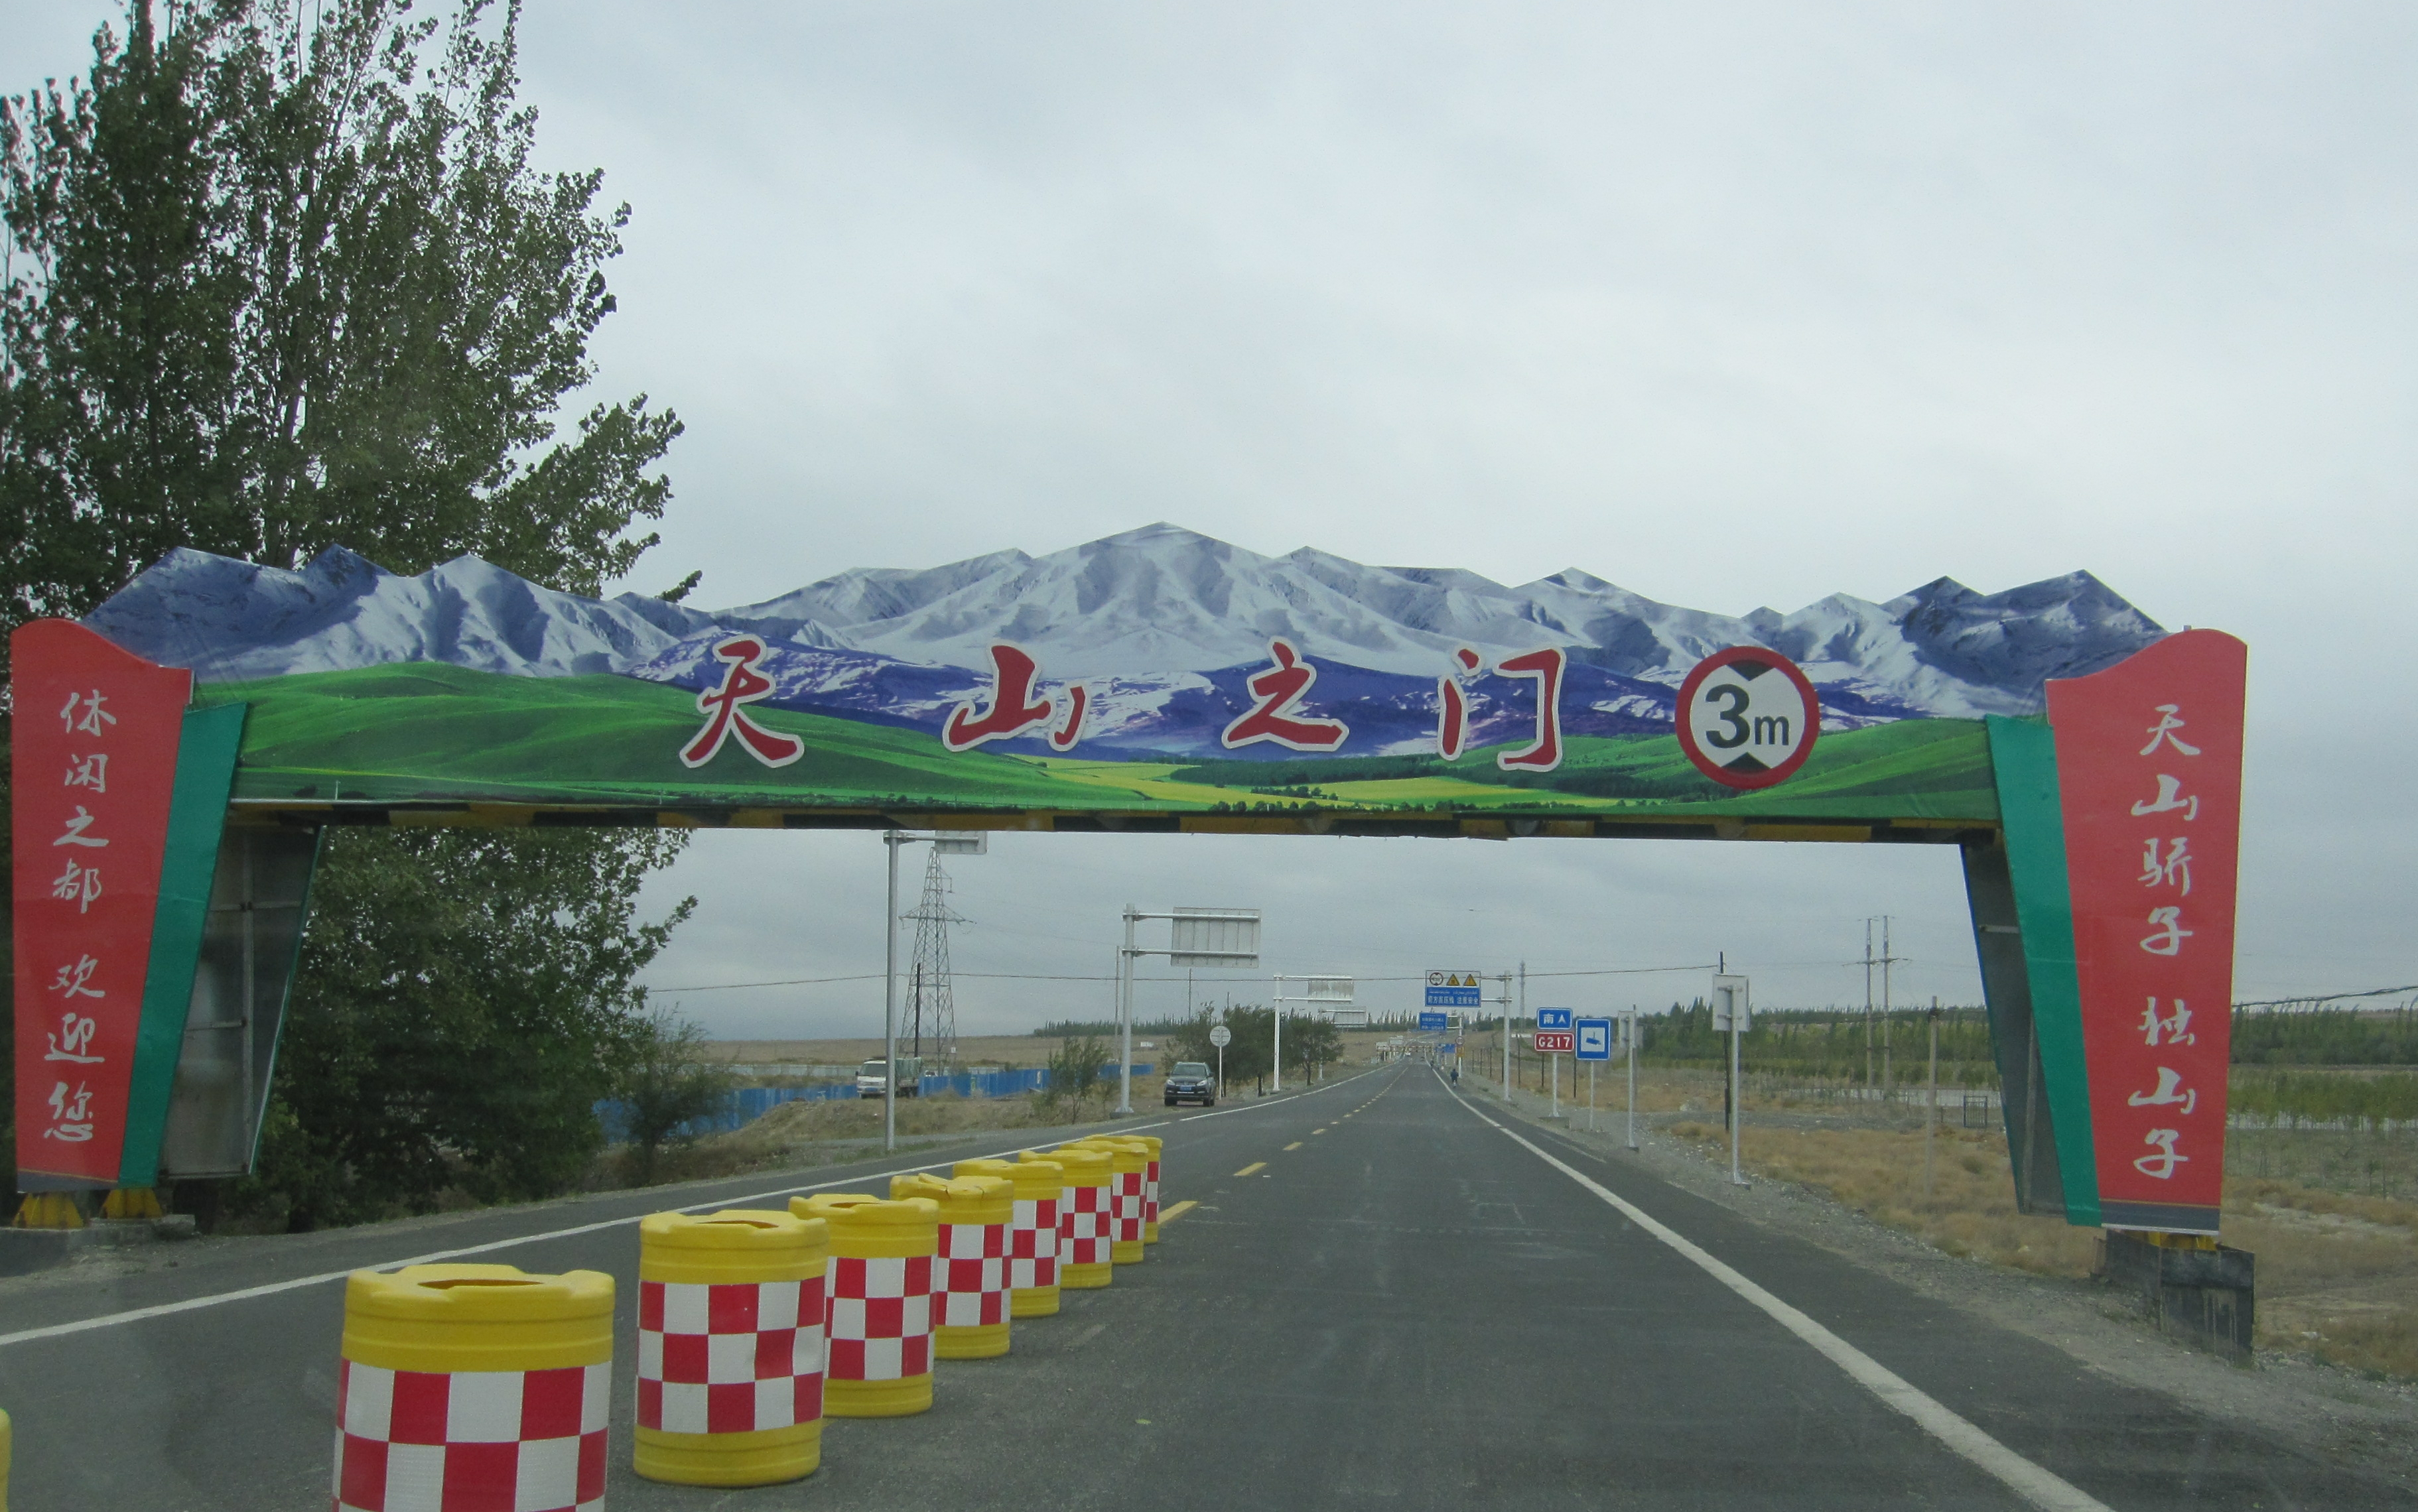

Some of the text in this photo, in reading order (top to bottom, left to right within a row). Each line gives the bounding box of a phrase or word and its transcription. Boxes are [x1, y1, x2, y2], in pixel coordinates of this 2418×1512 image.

[679, 633, 1566, 771] 天山之门
[1706, 684, 1789, 748] 3m
[44, 690, 116, 1141] 休闲之都 欢迎您
[2128, 704, 2201, 1179] 天山骄子 独山子
[1539, 1036, 1570, 1048] G217
[1543, 1013, 1554, 1025] 南
